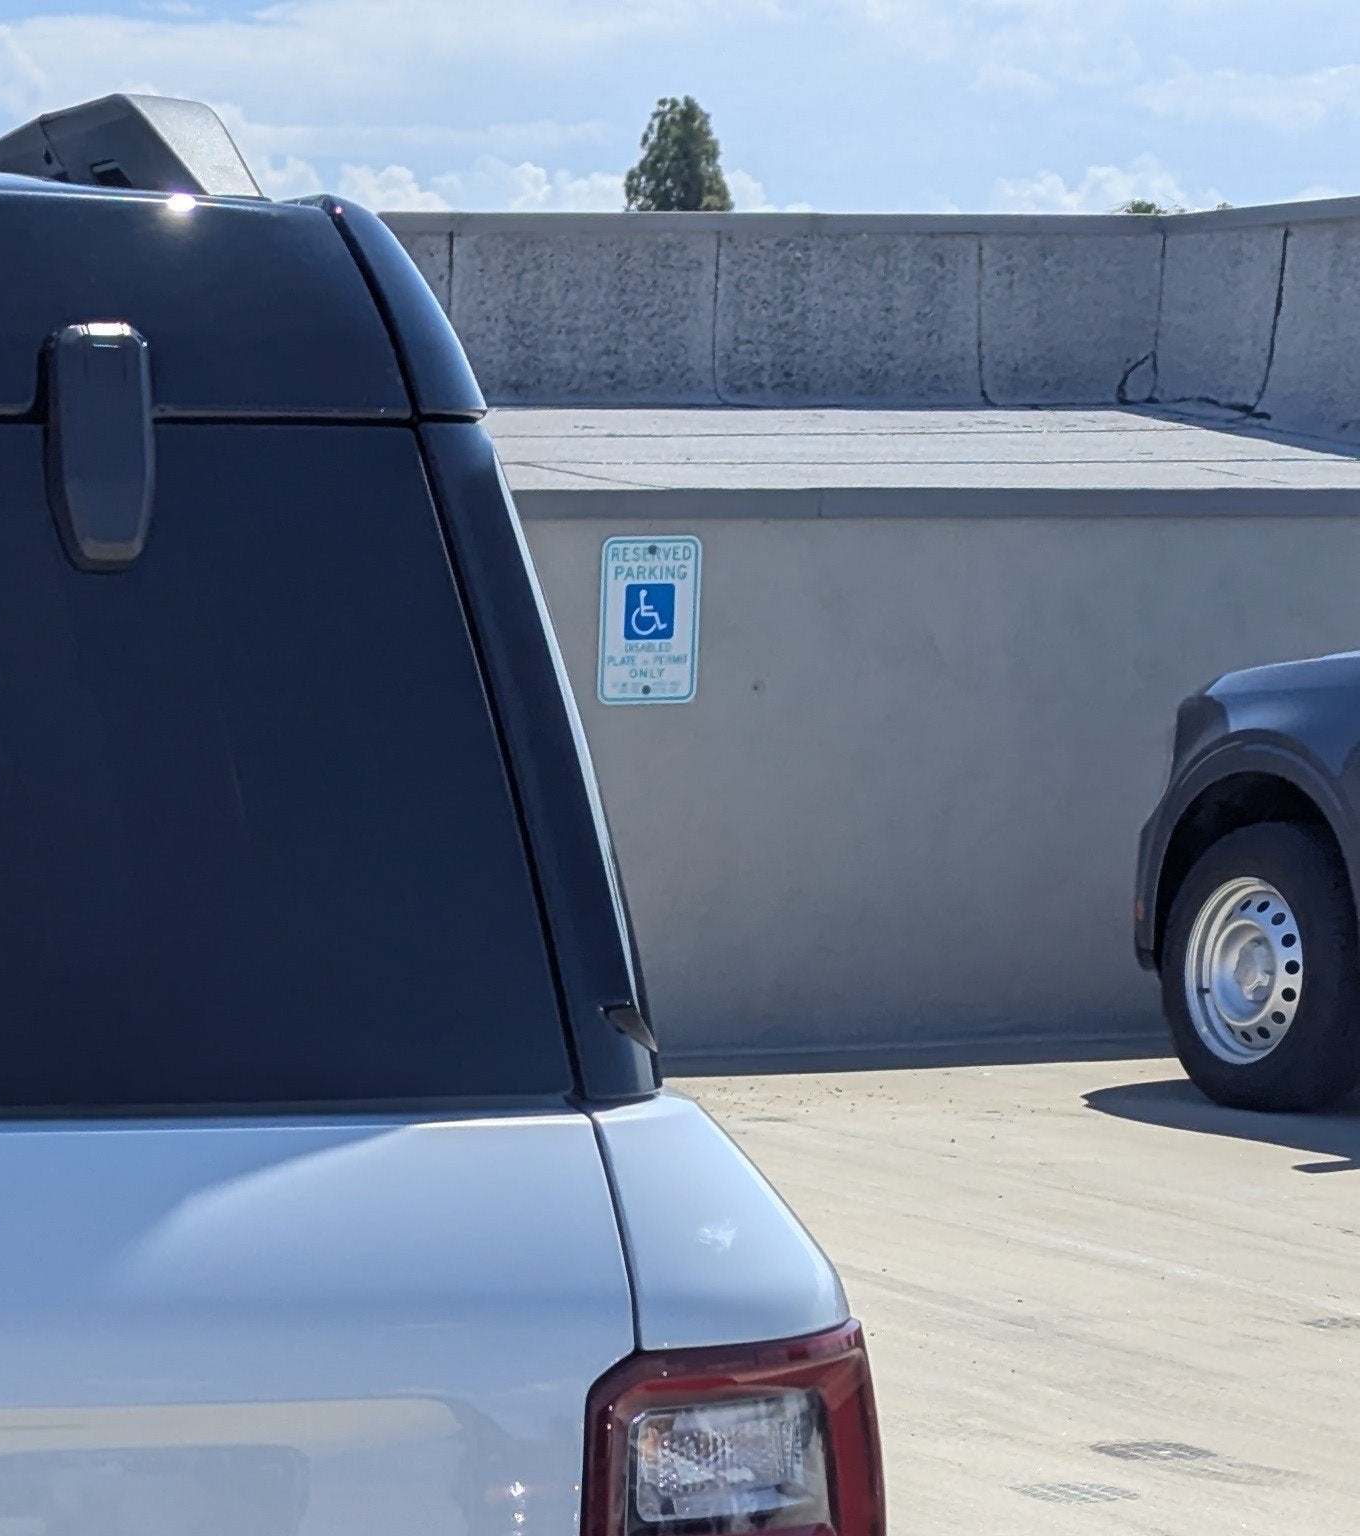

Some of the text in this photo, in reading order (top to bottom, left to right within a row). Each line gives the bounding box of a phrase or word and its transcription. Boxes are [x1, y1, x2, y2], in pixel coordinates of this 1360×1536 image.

[611, 545, 692, 562] RESERVED
[614, 564, 688, 580] PARKING
[629, 667, 665, 679] ONLY
